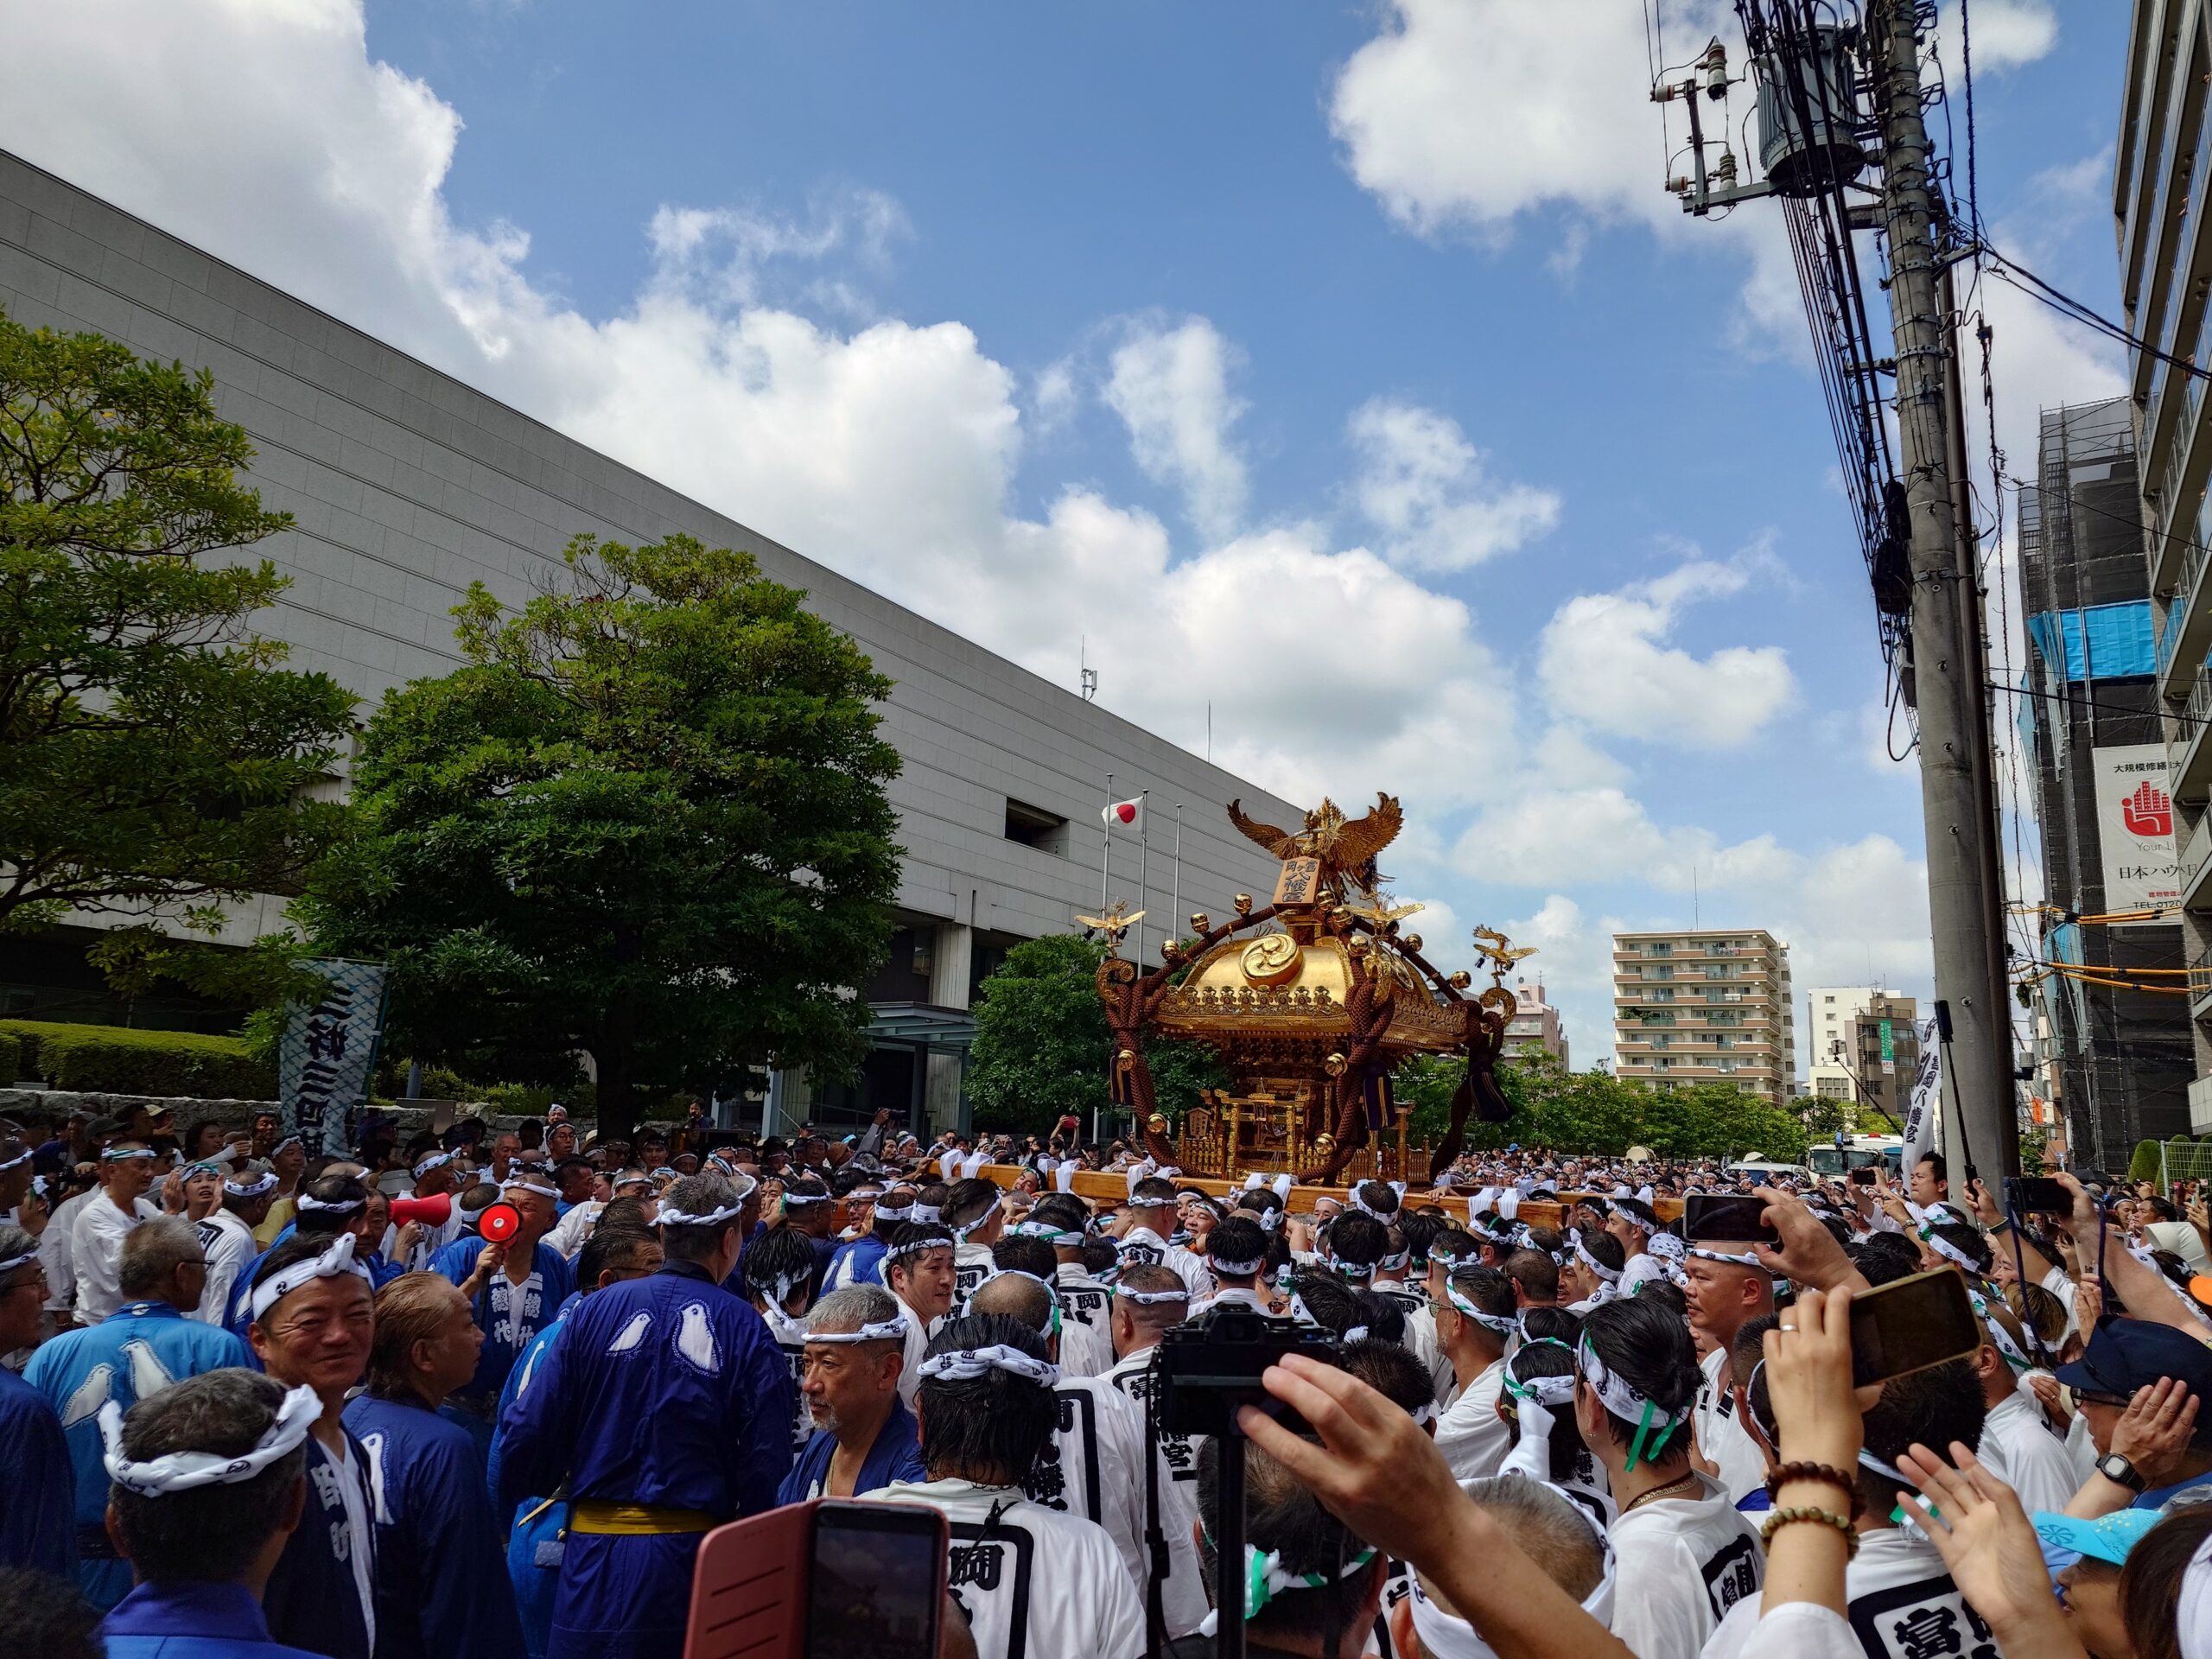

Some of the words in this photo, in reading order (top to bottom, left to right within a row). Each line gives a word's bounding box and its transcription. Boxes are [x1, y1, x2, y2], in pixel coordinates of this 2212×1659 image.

[2113, 761, 2167, 773] 大規模修繕
[2136, 842, 2162, 852] Your
